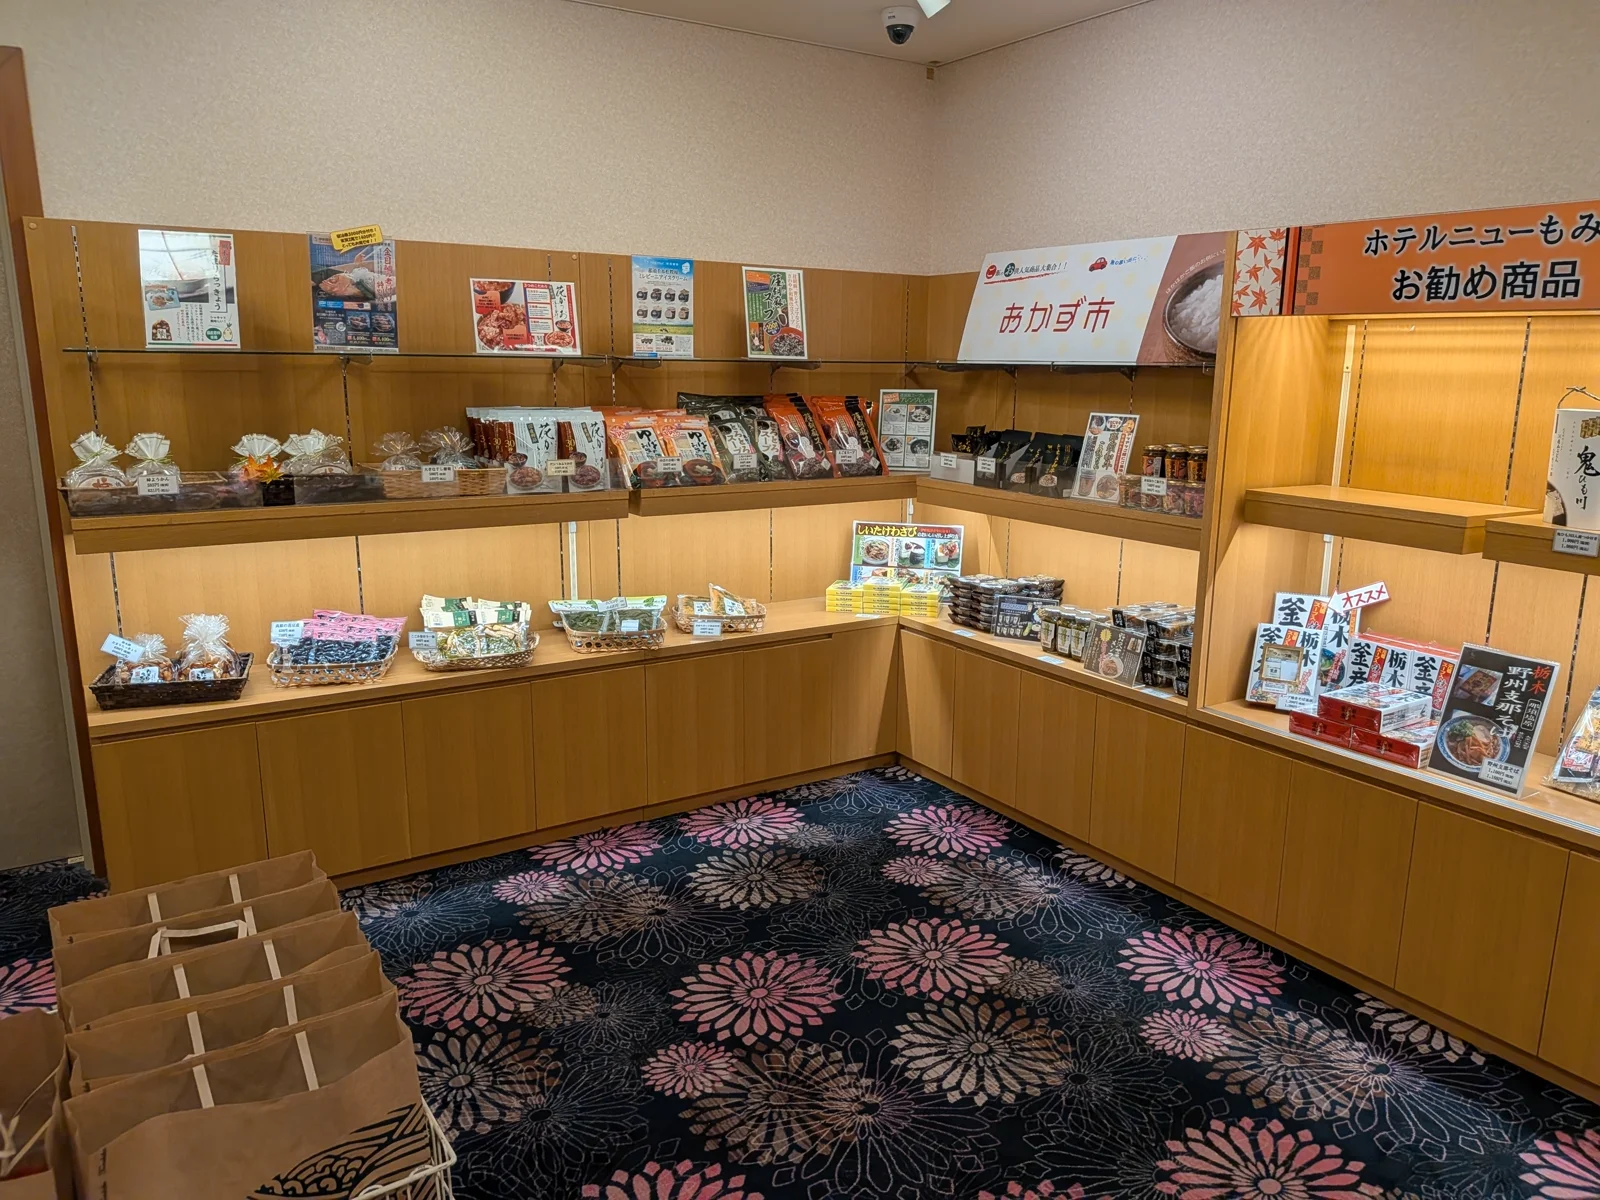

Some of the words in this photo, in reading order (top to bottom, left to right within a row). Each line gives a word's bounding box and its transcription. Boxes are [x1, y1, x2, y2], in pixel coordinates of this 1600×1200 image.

[1364, 213, 1600, 255] ホテルニューもみ
[1392, 260, 1581, 301] お勧め商品
[763, 292, 775, 320] スープ
[760, 430, 771, 452] スープ
[1573, 444, 1600, 510] 鬼ひも川
[857, 525, 918, 538] しいたけわさび
[1278, 597, 1309, 628] 釜
[1341, 584, 1386, 608] オススメ
[1299, 631, 1320, 668] 栃木
[1386, 649, 1408, 688] 栃木
[1527, 665, 1552, 695] 栃木
[1489, 665, 1534, 738] 野州支那そば
